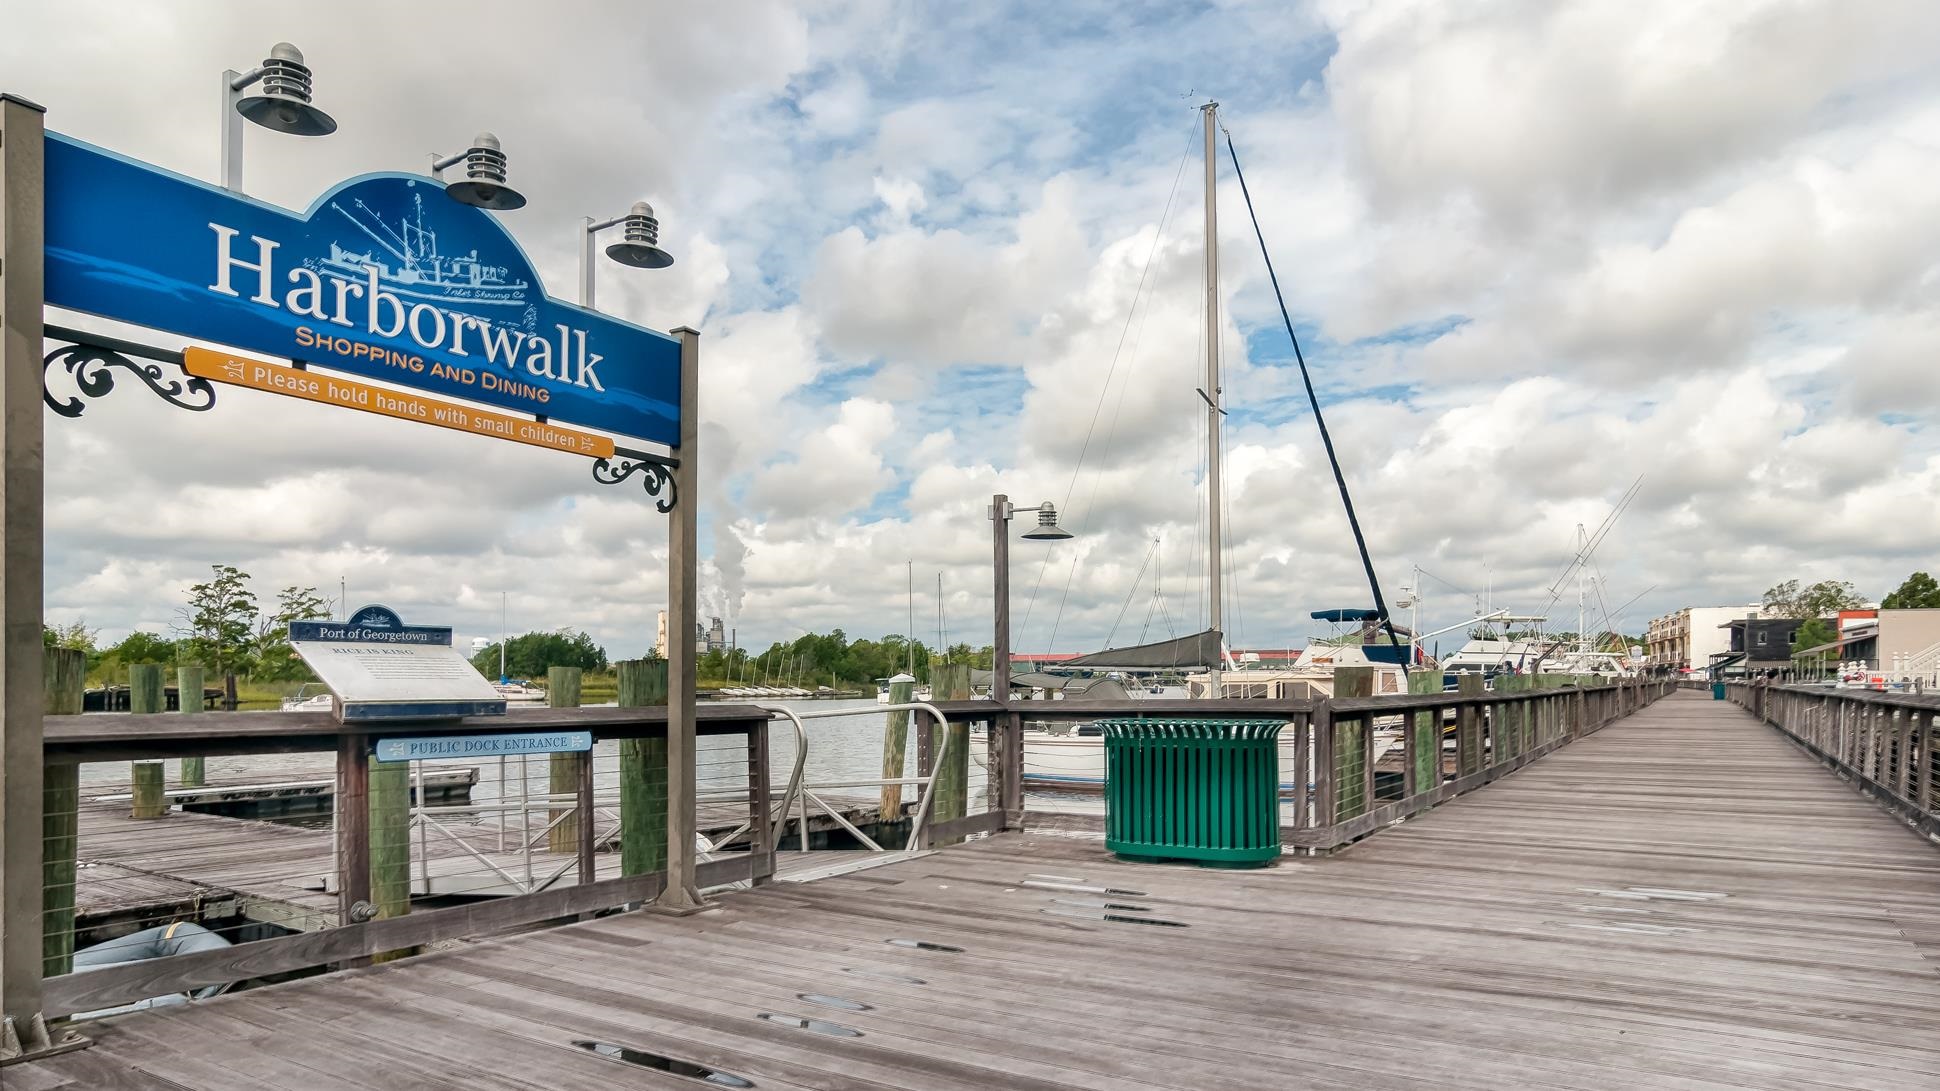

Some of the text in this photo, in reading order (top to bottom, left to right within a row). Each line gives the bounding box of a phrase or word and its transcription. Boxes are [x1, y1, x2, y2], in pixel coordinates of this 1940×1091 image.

[208, 222, 606, 392] Harborwalk
[295, 326, 550, 403] SHOPPING AND DINING
[254, 367, 576, 447] Please hold hands with small children
[319, 627, 428, 642] Port of Georgetown
[410, 736, 568, 755] PUBLIC DOCK ENTRANCE
